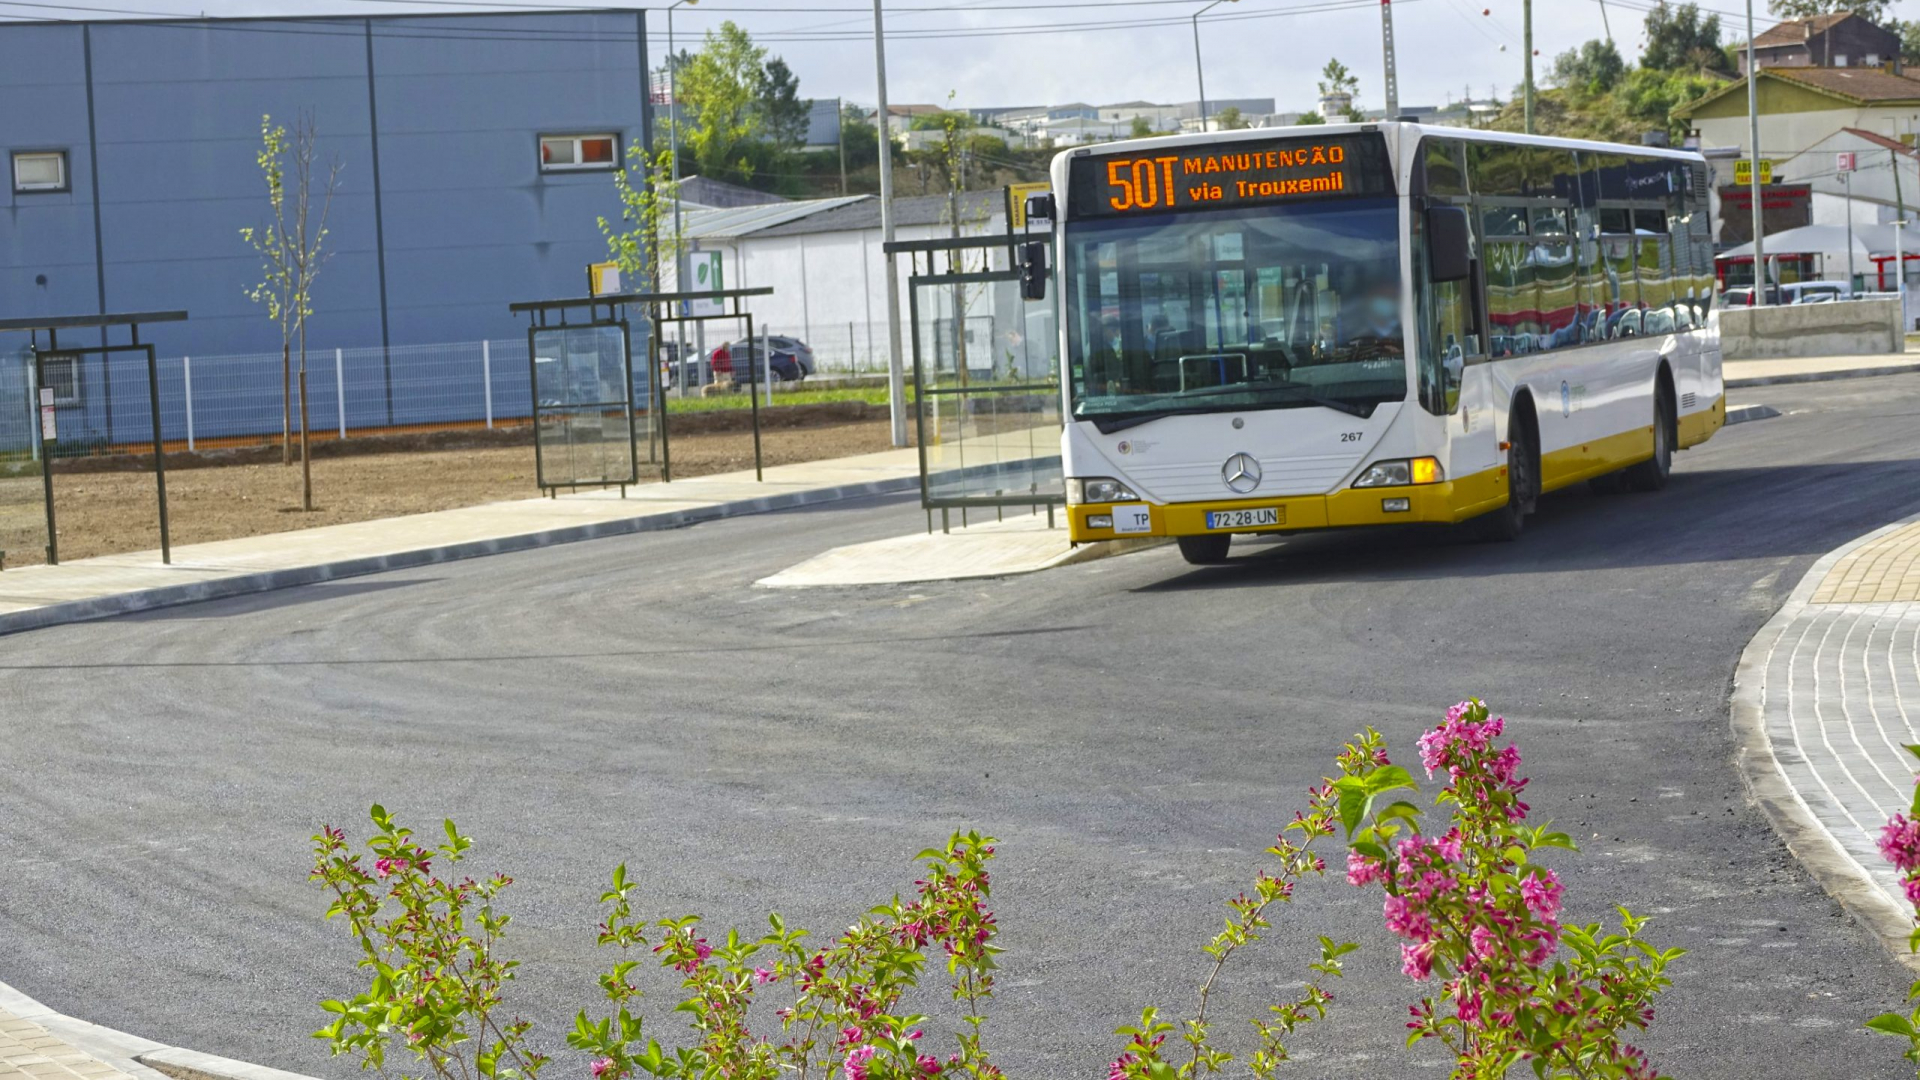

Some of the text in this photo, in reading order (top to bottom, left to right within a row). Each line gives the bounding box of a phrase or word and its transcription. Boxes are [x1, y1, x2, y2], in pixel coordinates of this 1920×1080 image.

[1183, 146, 1344, 175] MANUTENÇÃO
[1736, 162, 1770, 173] ABETO
[1107, 156, 1179, 210] 50T
[1189, 171, 1343, 201] via Trouxemil
[1340, 431, 1363, 442] 267
[1133, 513, 1149, 525] TP
